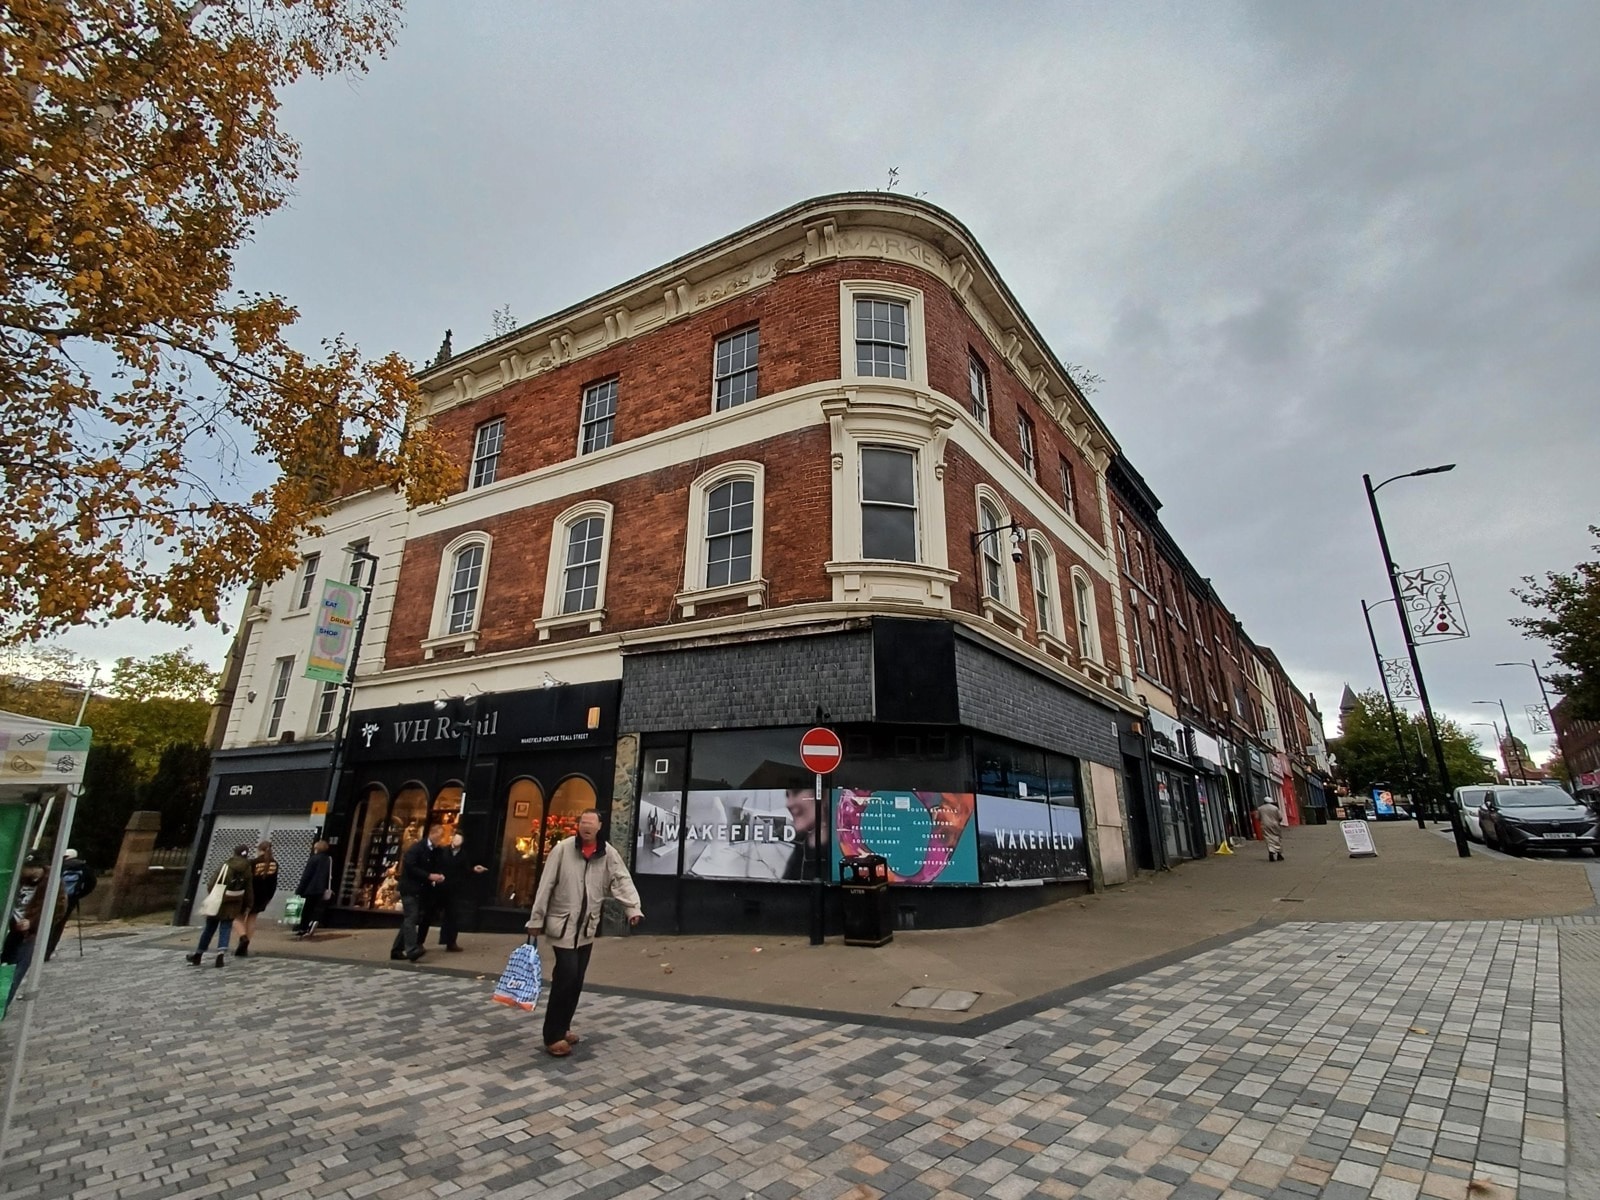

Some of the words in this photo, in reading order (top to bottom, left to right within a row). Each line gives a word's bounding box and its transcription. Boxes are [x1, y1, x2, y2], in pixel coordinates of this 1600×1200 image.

[325, 600, 338, 608] EAT
[330, 616, 351, 625] DRINK
[319, 628, 338, 636] SHOP
[393, 719, 431, 743] WH
[229, 785, 253, 795] GHIA
[665, 824, 796, 841] WAKEFIELD
[994, 828, 1074, 850] WAKEFIELD
